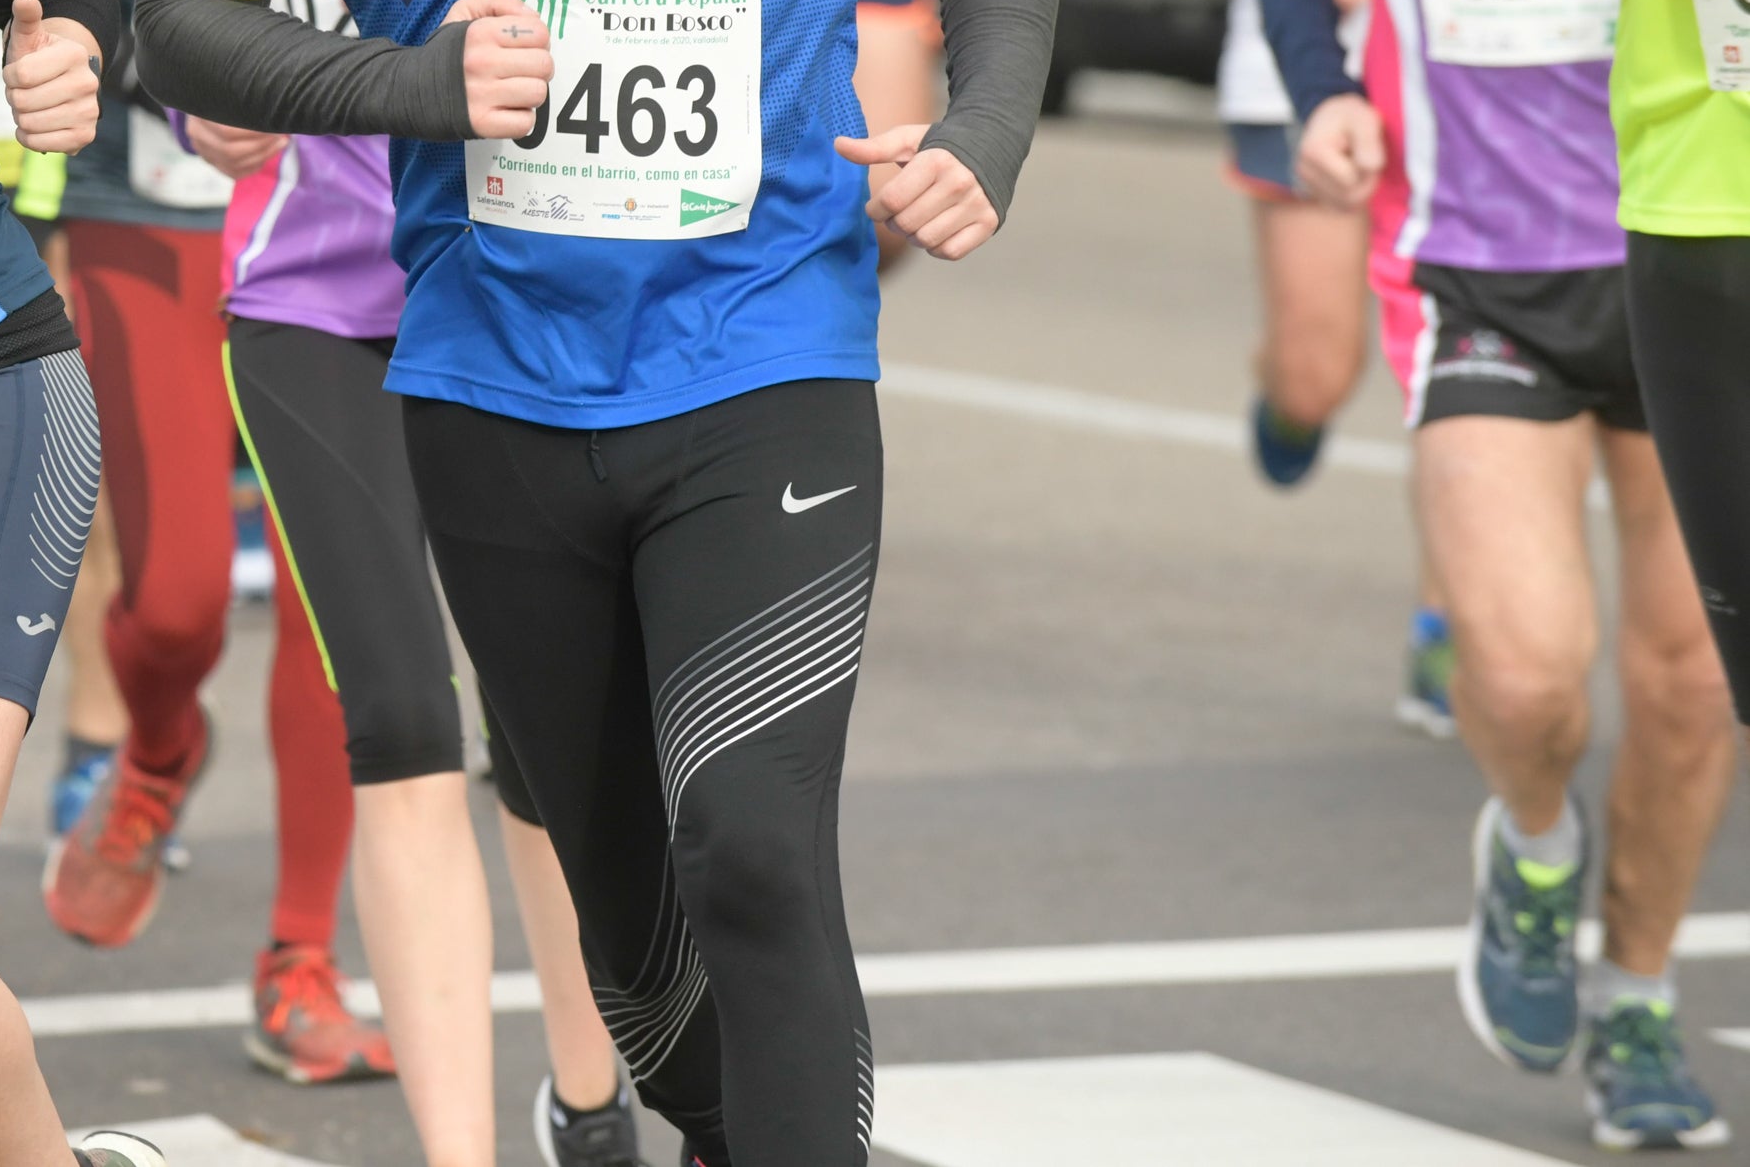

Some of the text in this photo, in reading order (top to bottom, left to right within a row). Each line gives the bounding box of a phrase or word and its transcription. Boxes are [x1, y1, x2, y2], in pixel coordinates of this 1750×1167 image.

[590, 7, 746, 32] "Don Bosco"
[605, 36, 611, 44] 9
[612, 36, 623, 44] de
[625, 35, 658, 45] febrero
[660, 36, 670, 45] de
[672, 36, 692, 46] 2020,
[492, 155, 557, 176] “Corriendo
[562, 164, 577, 177] en
[581, 164, 592, 178] el
[597, 165, 640, 182] barrio,
[645, 168, 680, 181] como
[684, 168, 698, 180] en
[477, 196, 515, 209] salesianos
[522, 208, 550, 218] ALESTE
